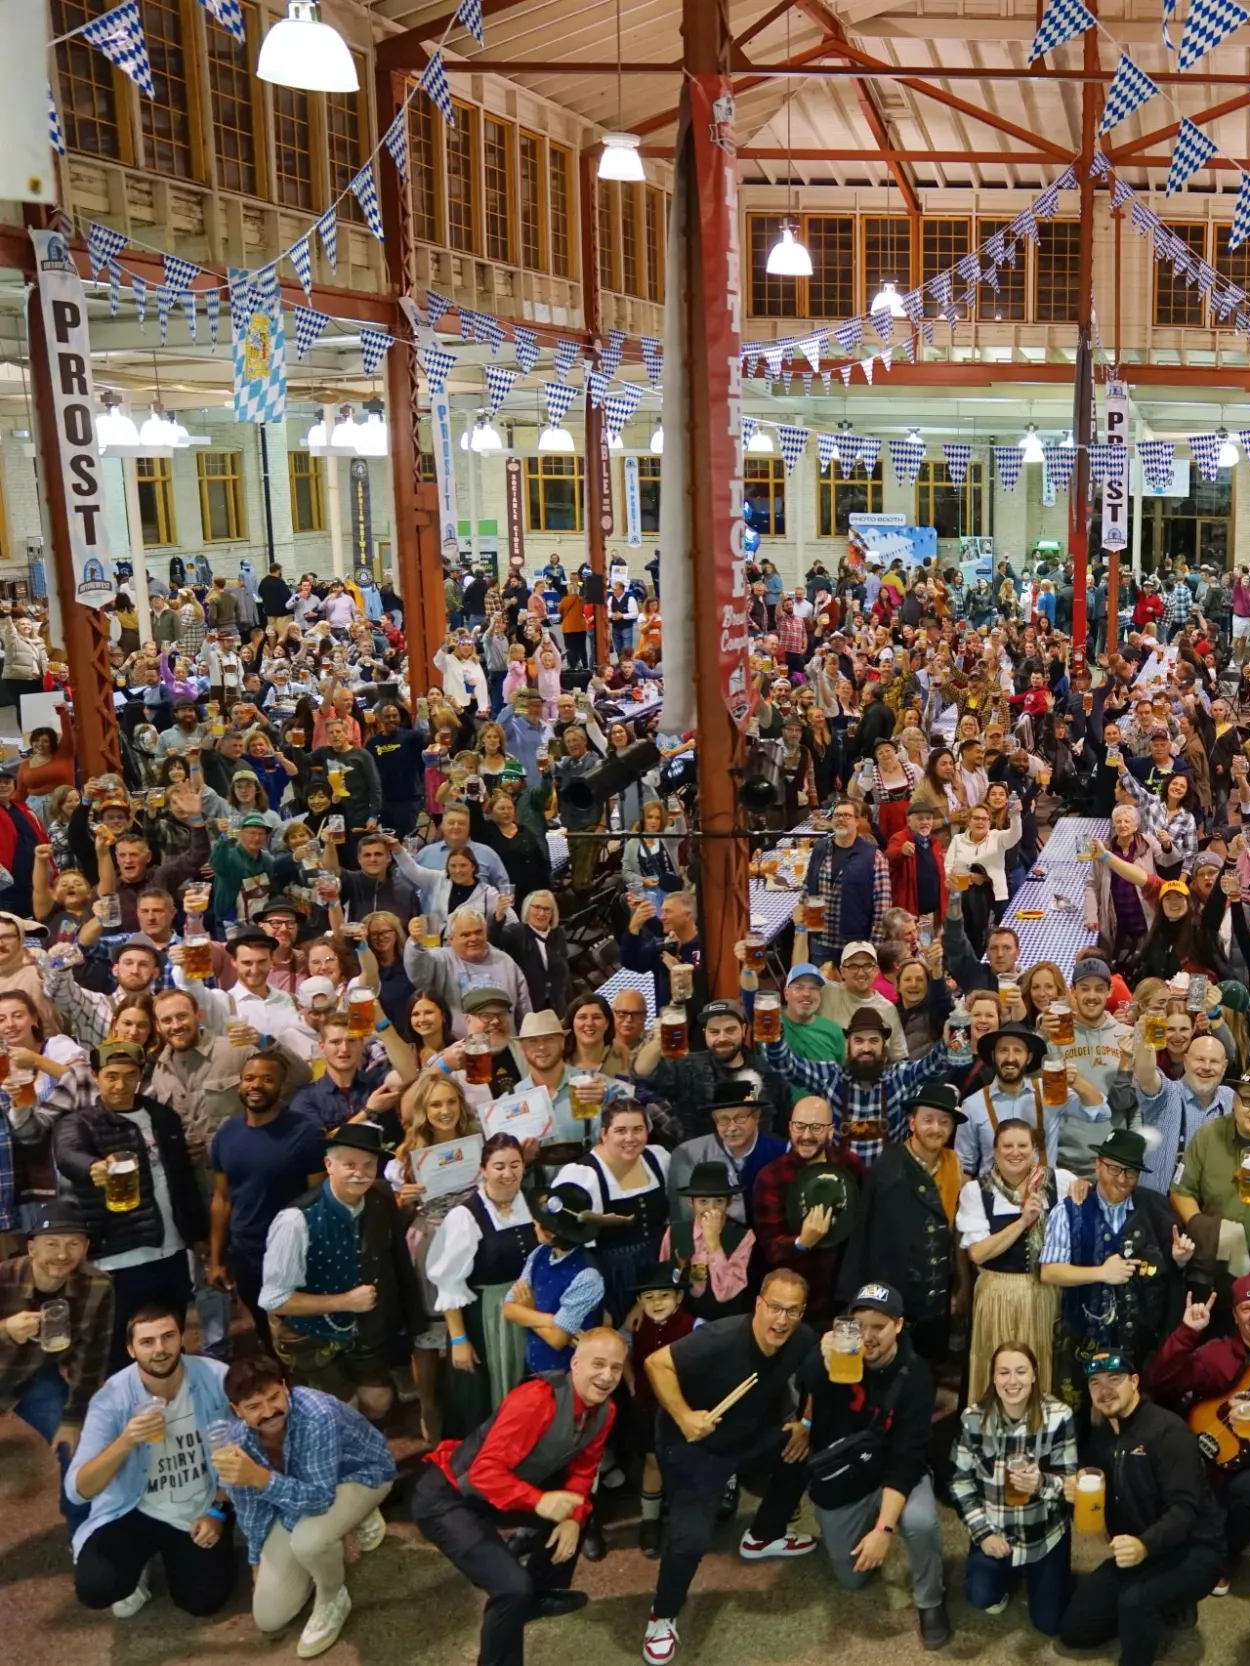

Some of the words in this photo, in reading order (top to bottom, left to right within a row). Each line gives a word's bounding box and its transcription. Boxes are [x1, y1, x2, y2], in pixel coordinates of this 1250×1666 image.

[51, 299, 101, 546] PROST
[1106, 411, 1124, 522] PRST
[878, 515, 903, 523] BOOTH
[1096, 1045, 1123, 1059] GOPHE
[858, 1284, 890, 1302] AEW
